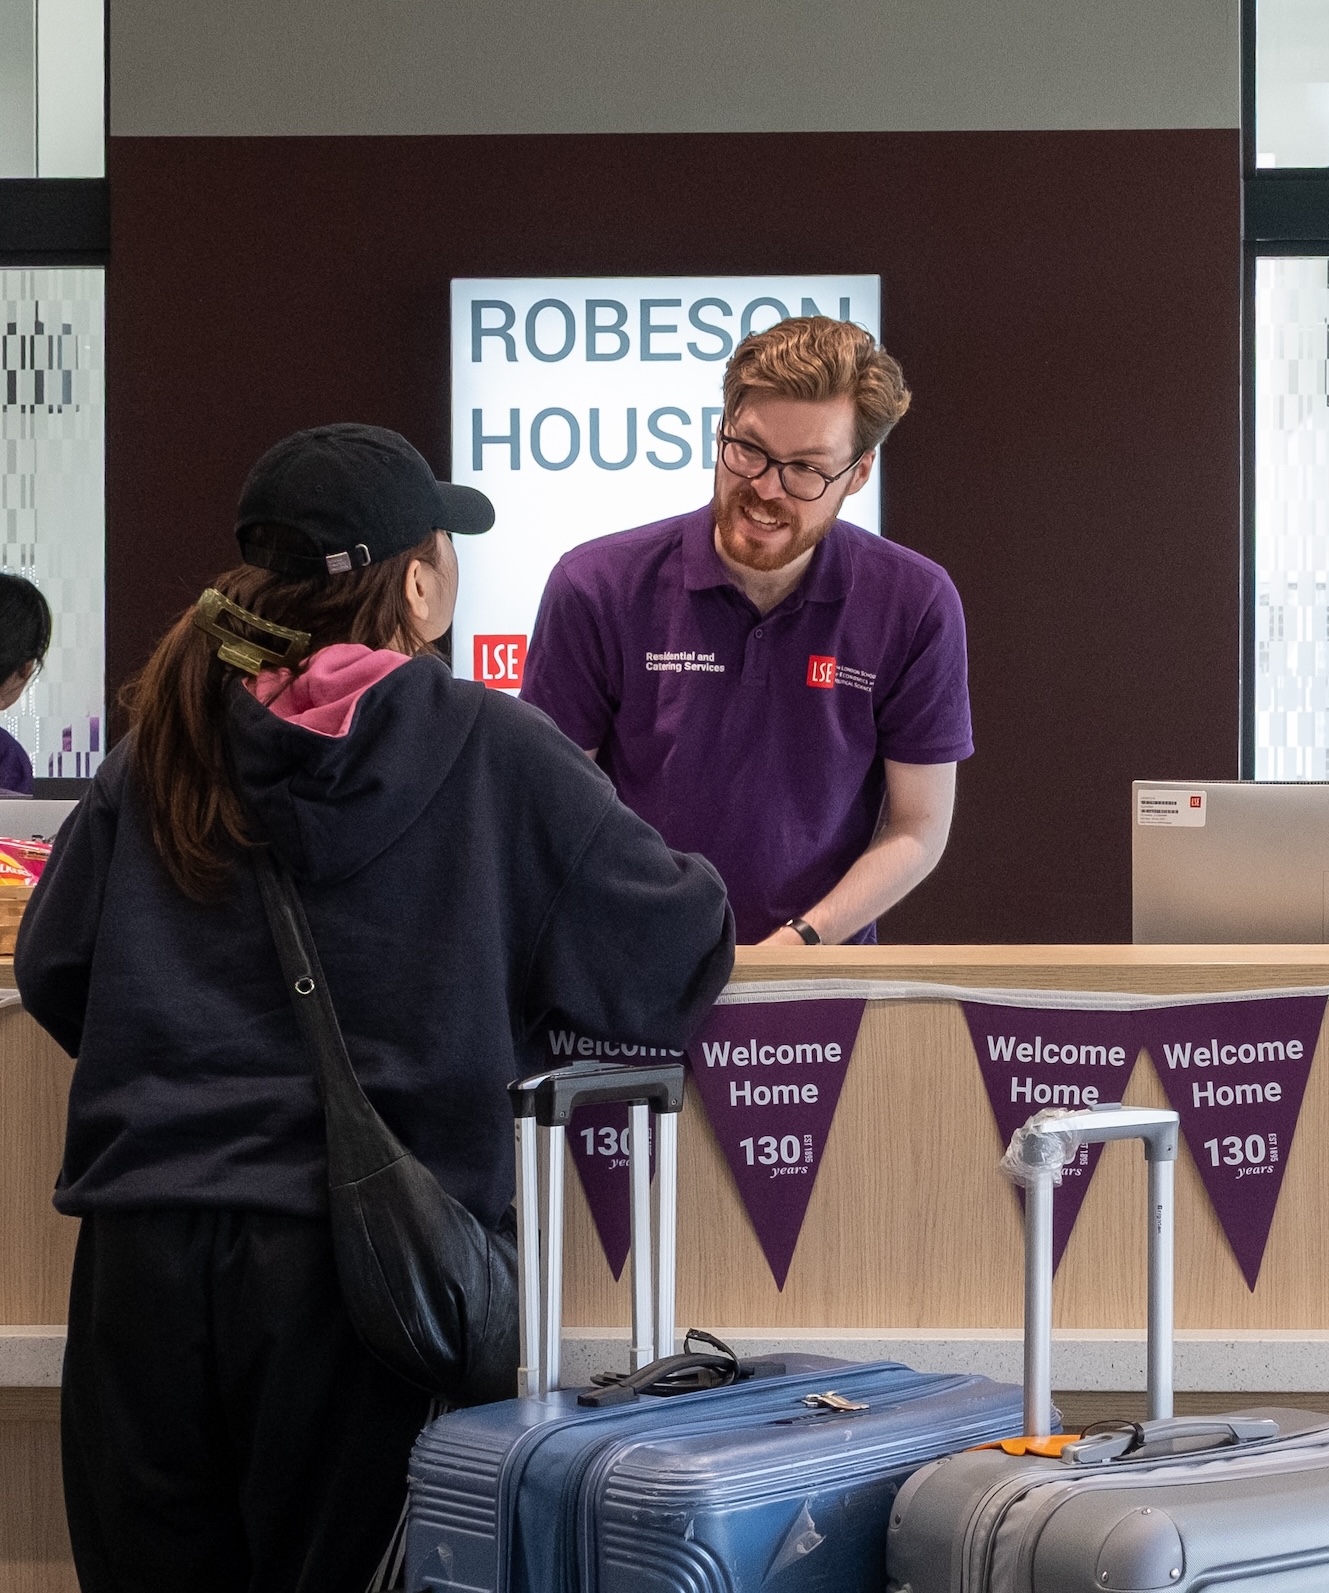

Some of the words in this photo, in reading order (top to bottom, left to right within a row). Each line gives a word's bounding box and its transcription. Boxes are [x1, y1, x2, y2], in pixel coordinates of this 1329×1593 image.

[471, 297, 850, 362] ROBES
[472, 406, 722, 471] HOUS
[482, 644, 519, 680] LSE
[646, 651, 695, 661] Residential
[697, 652, 715, 662] and
[646, 662, 682, 672] Catering
[684, 662, 725, 672] Services
[812, 661, 833, 683] LSE
[702, 1039, 842, 1067] Welcome
[987, 1035, 1126, 1066] Welcome
[1162, 1038, 1304, 1070] Welcome
[729, 1080, 819, 1106] Home
[1010, 1076, 1099, 1105] Home
[1192, 1081, 1282, 1108] Home
[739, 1134, 800, 1166] 130
[803, 1134, 812, 1146] EST
[1203, 1134, 1266, 1167] 130
[1267, 1133, 1277, 1145] EST
[770, 1165, 808, 1179] years
[1061, 1166, 1083, 1176] ars
[1235, 1165, 1274, 1179] years
